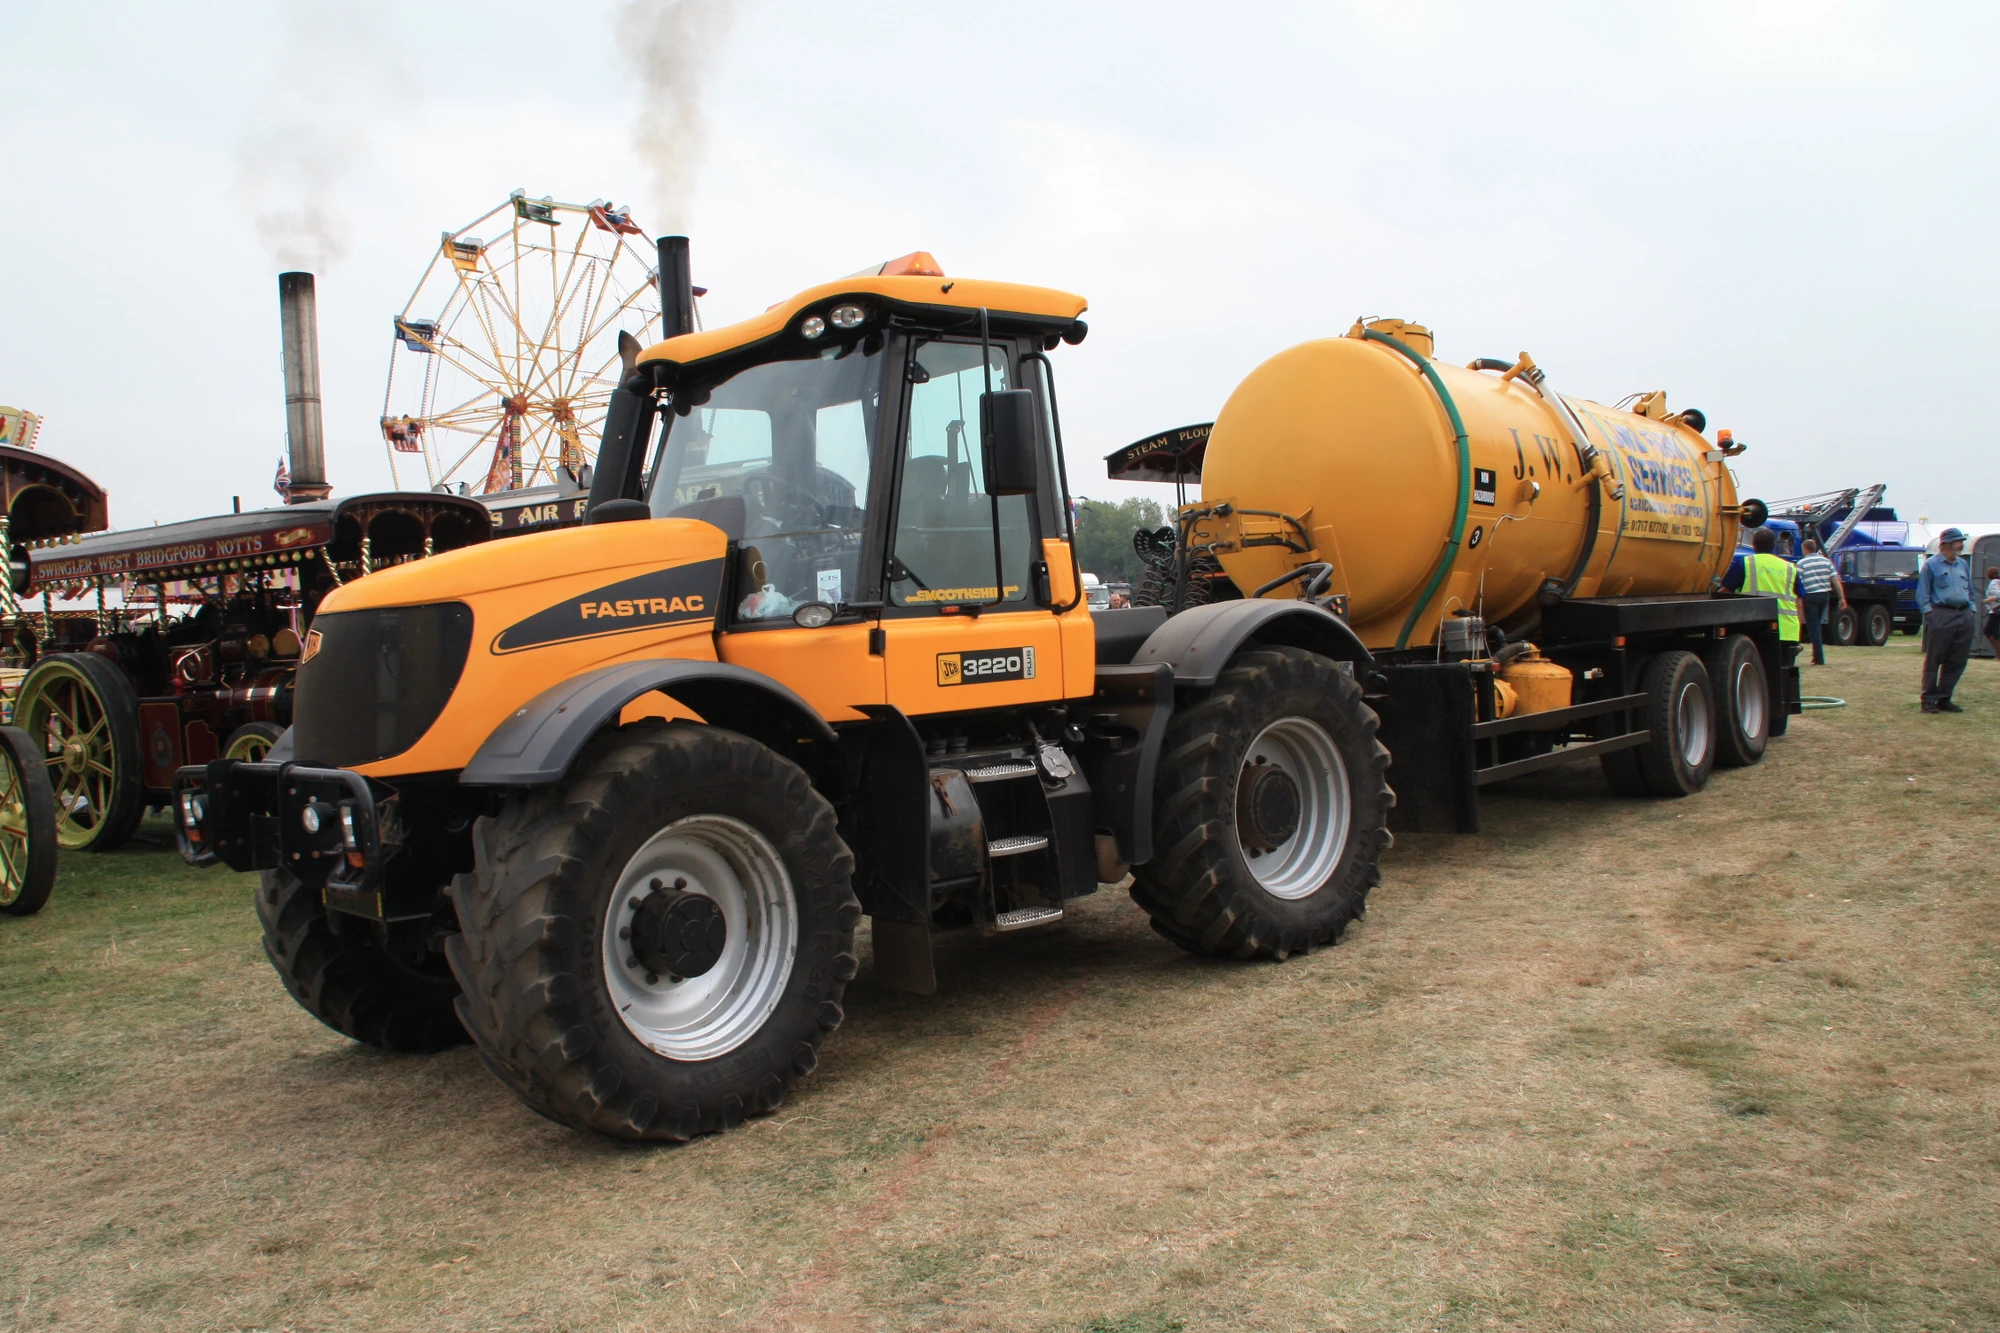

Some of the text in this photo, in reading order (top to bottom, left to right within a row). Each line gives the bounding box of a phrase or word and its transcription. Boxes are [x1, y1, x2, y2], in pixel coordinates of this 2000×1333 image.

[1127, 427, 1212, 459] STEAM PLOU
[1627, 455, 1696, 500] SERVICES
[518, 504, 559, 524] AIR
[1471, 529, 1480, 545] 3
[38, 558, 93, 579] SWINGLER
[98, 552, 131, 571] WEST
[137, 543, 206, 567] BRIDGFORD
[215, 535, 263, 558] NOTTS
[580, 595, 705, 619] FASTRAC
[943, 656, 1021, 678] JCB 3220
